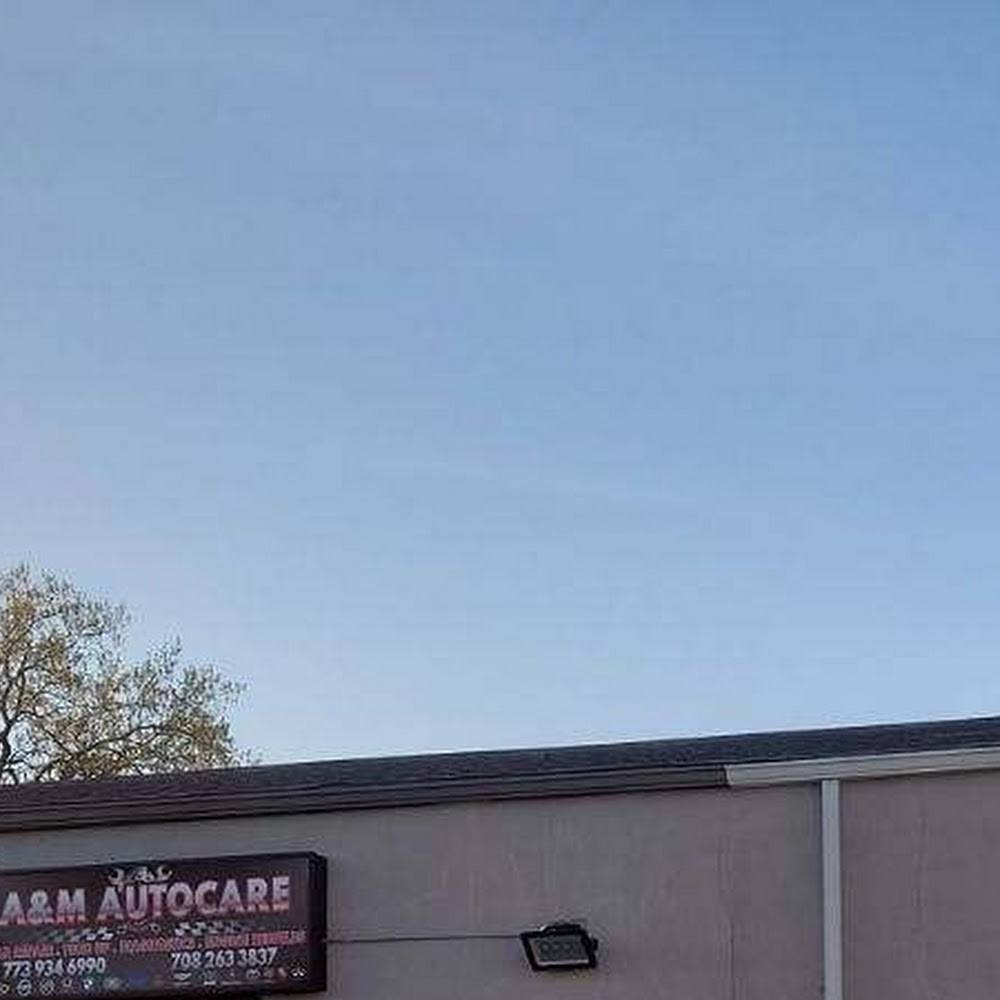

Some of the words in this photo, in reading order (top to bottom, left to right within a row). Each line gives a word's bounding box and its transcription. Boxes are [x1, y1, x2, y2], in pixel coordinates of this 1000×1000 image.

[0, 887, 85, 924] A&M
[97, 875, 290, 920] AUTOCARE
[3, 961, 32, 978] 773
[35, 959, 64, 976] 934
[66, 956, 107, 975] 6990
[171, 952, 202, 969] 708
[204, 950, 235, 968] 263
[237, 947, 278, 966] 3837
